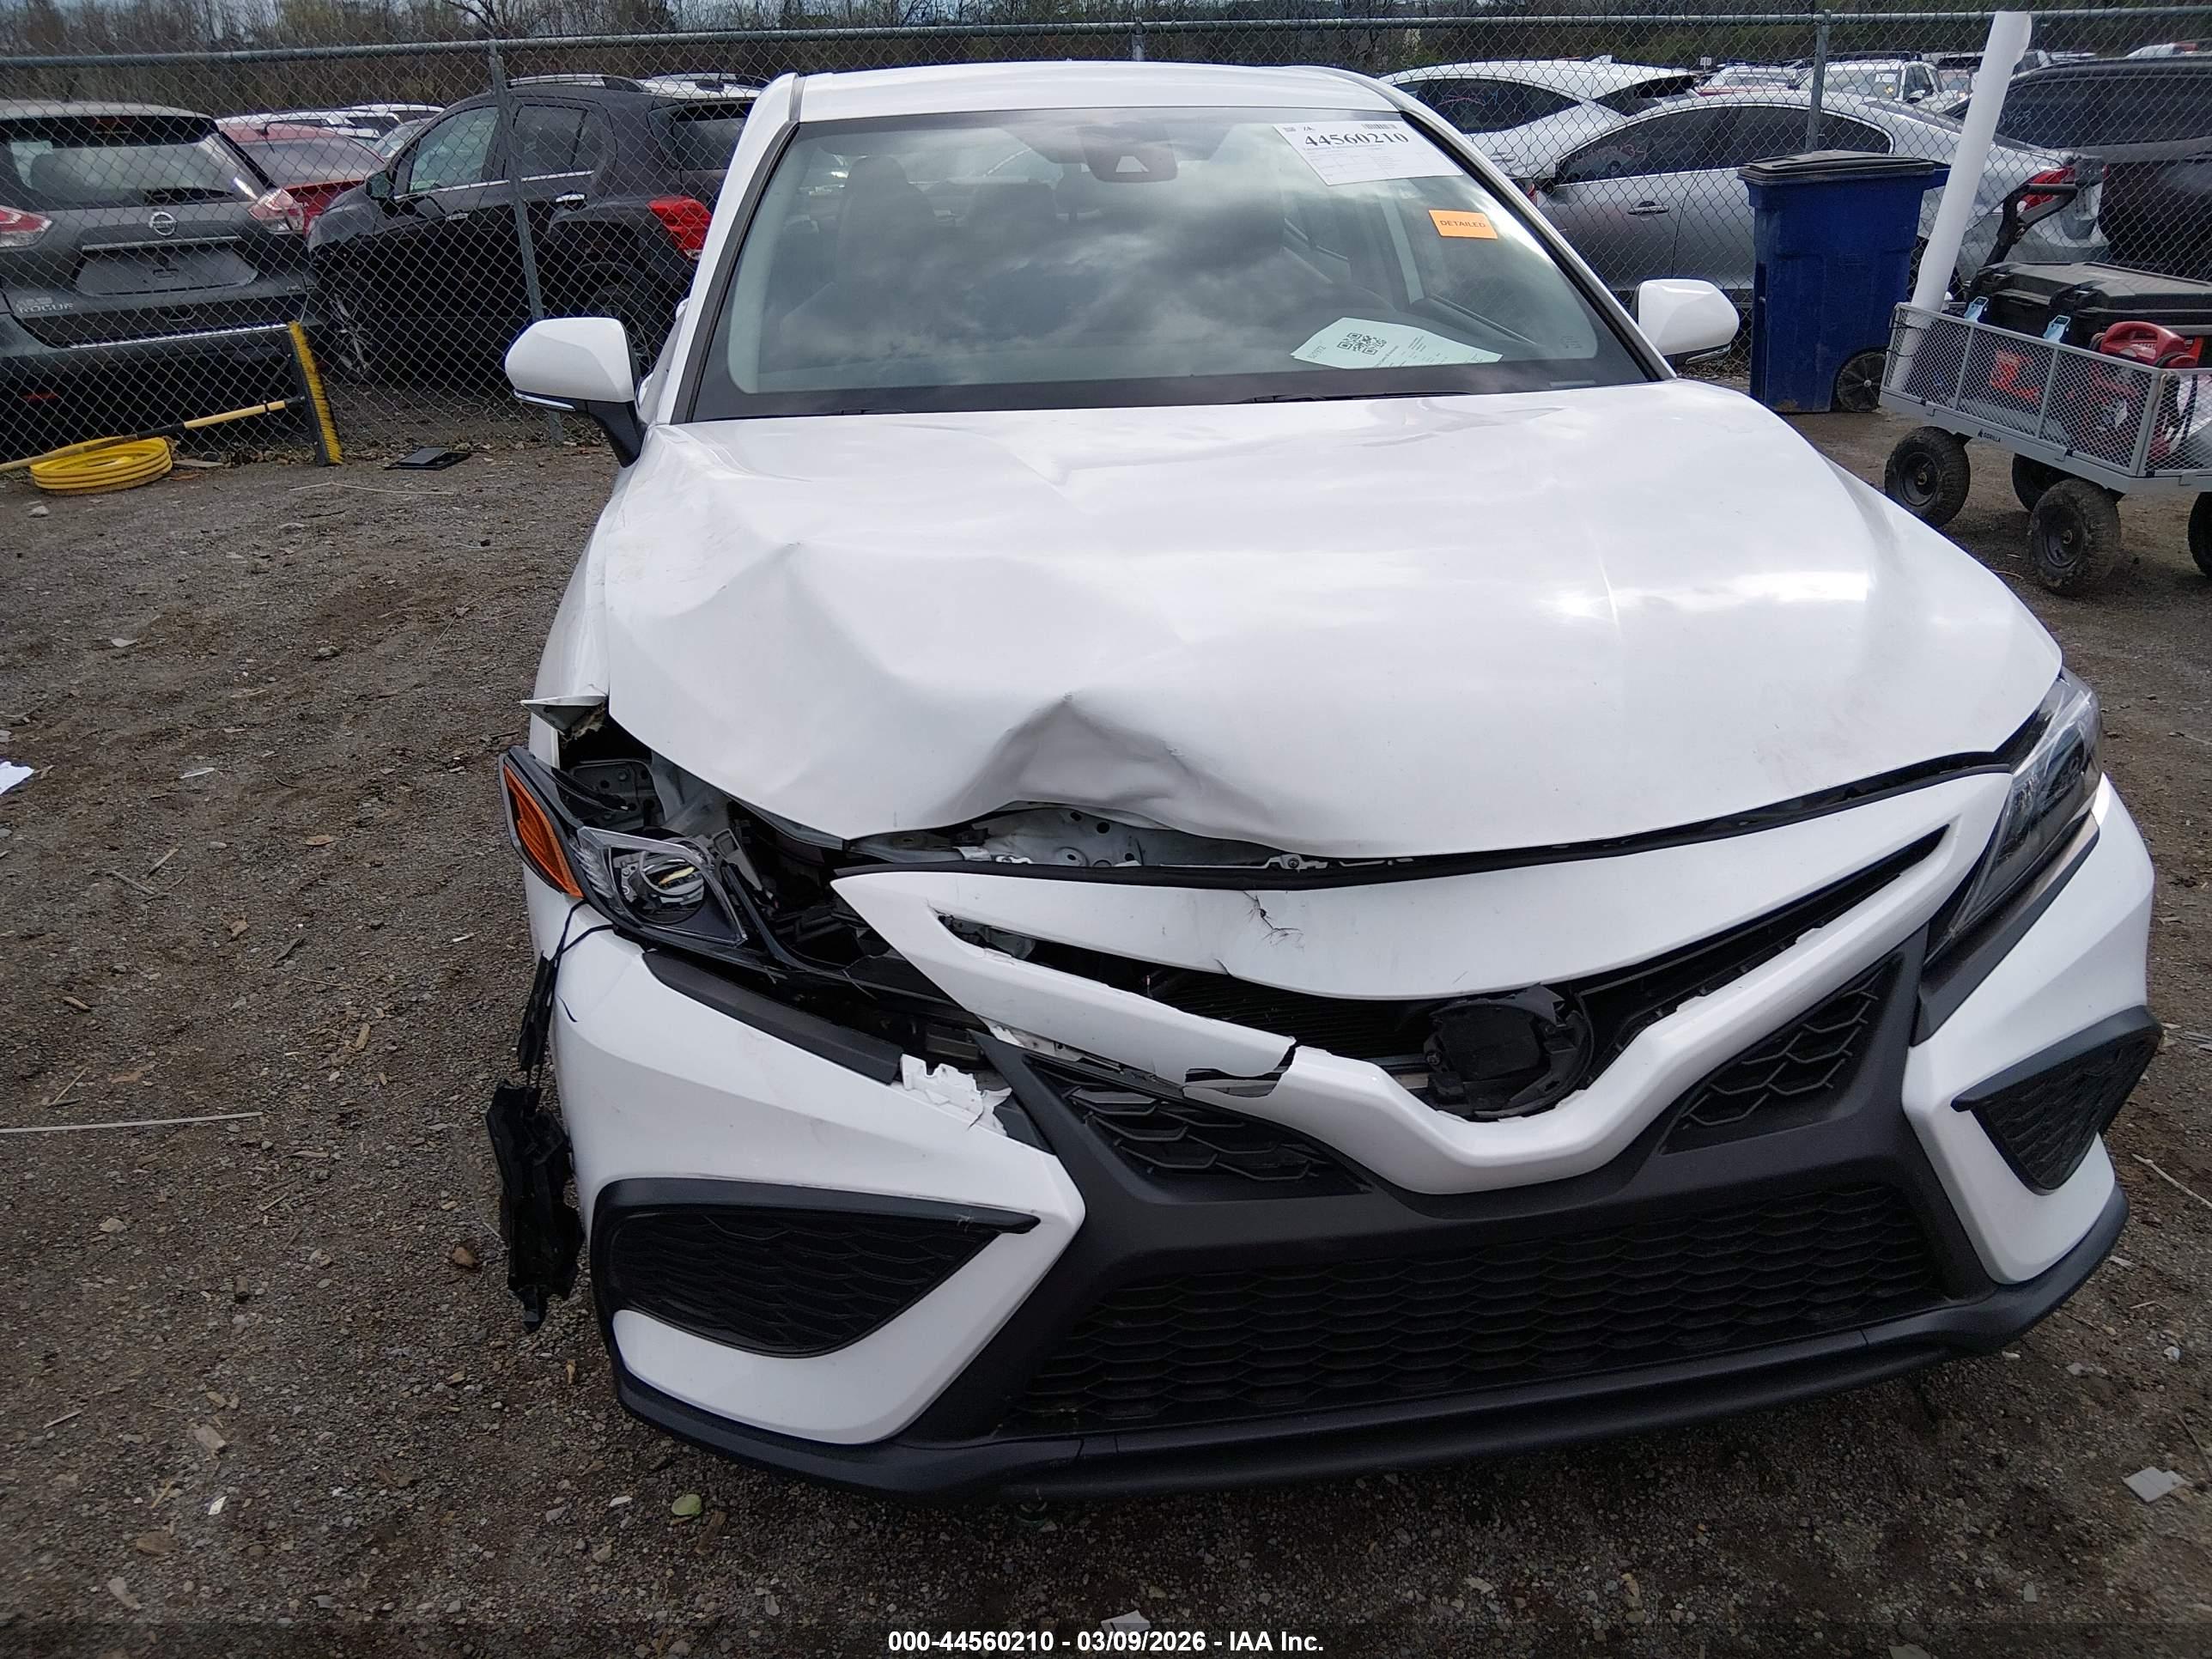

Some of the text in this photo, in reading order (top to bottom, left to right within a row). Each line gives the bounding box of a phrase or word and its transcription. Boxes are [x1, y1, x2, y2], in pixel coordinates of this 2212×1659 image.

[1304, 132, 1409, 147] 44560210
[1440, 219, 1486, 228] DETAILED
[20, 302, 74, 313] ROGUE
[1984, 433, 2001, 443] GORILLA
